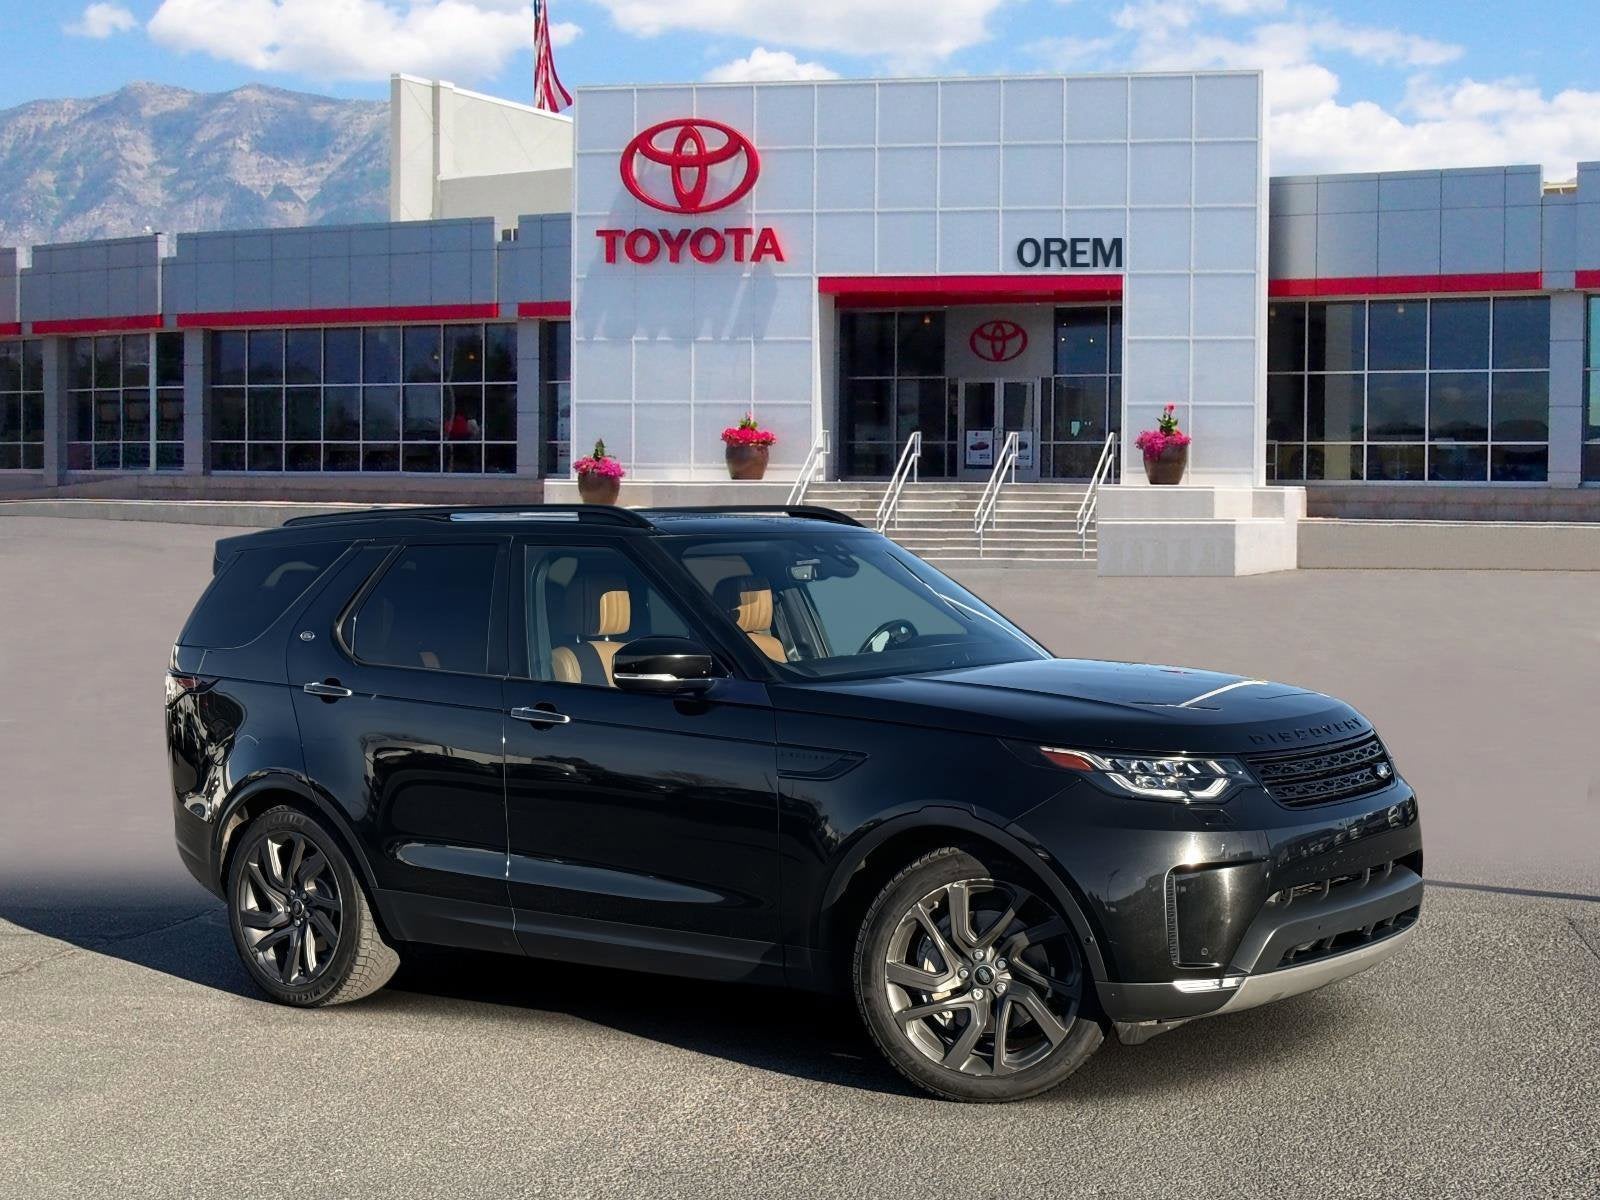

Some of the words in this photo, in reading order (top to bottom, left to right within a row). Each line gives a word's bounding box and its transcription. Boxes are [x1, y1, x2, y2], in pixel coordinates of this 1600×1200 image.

[596, 227, 785, 264] TOYOTA
[1017, 237, 1123, 268] OREM
[1247, 717, 1362, 745] DISCOVERY
